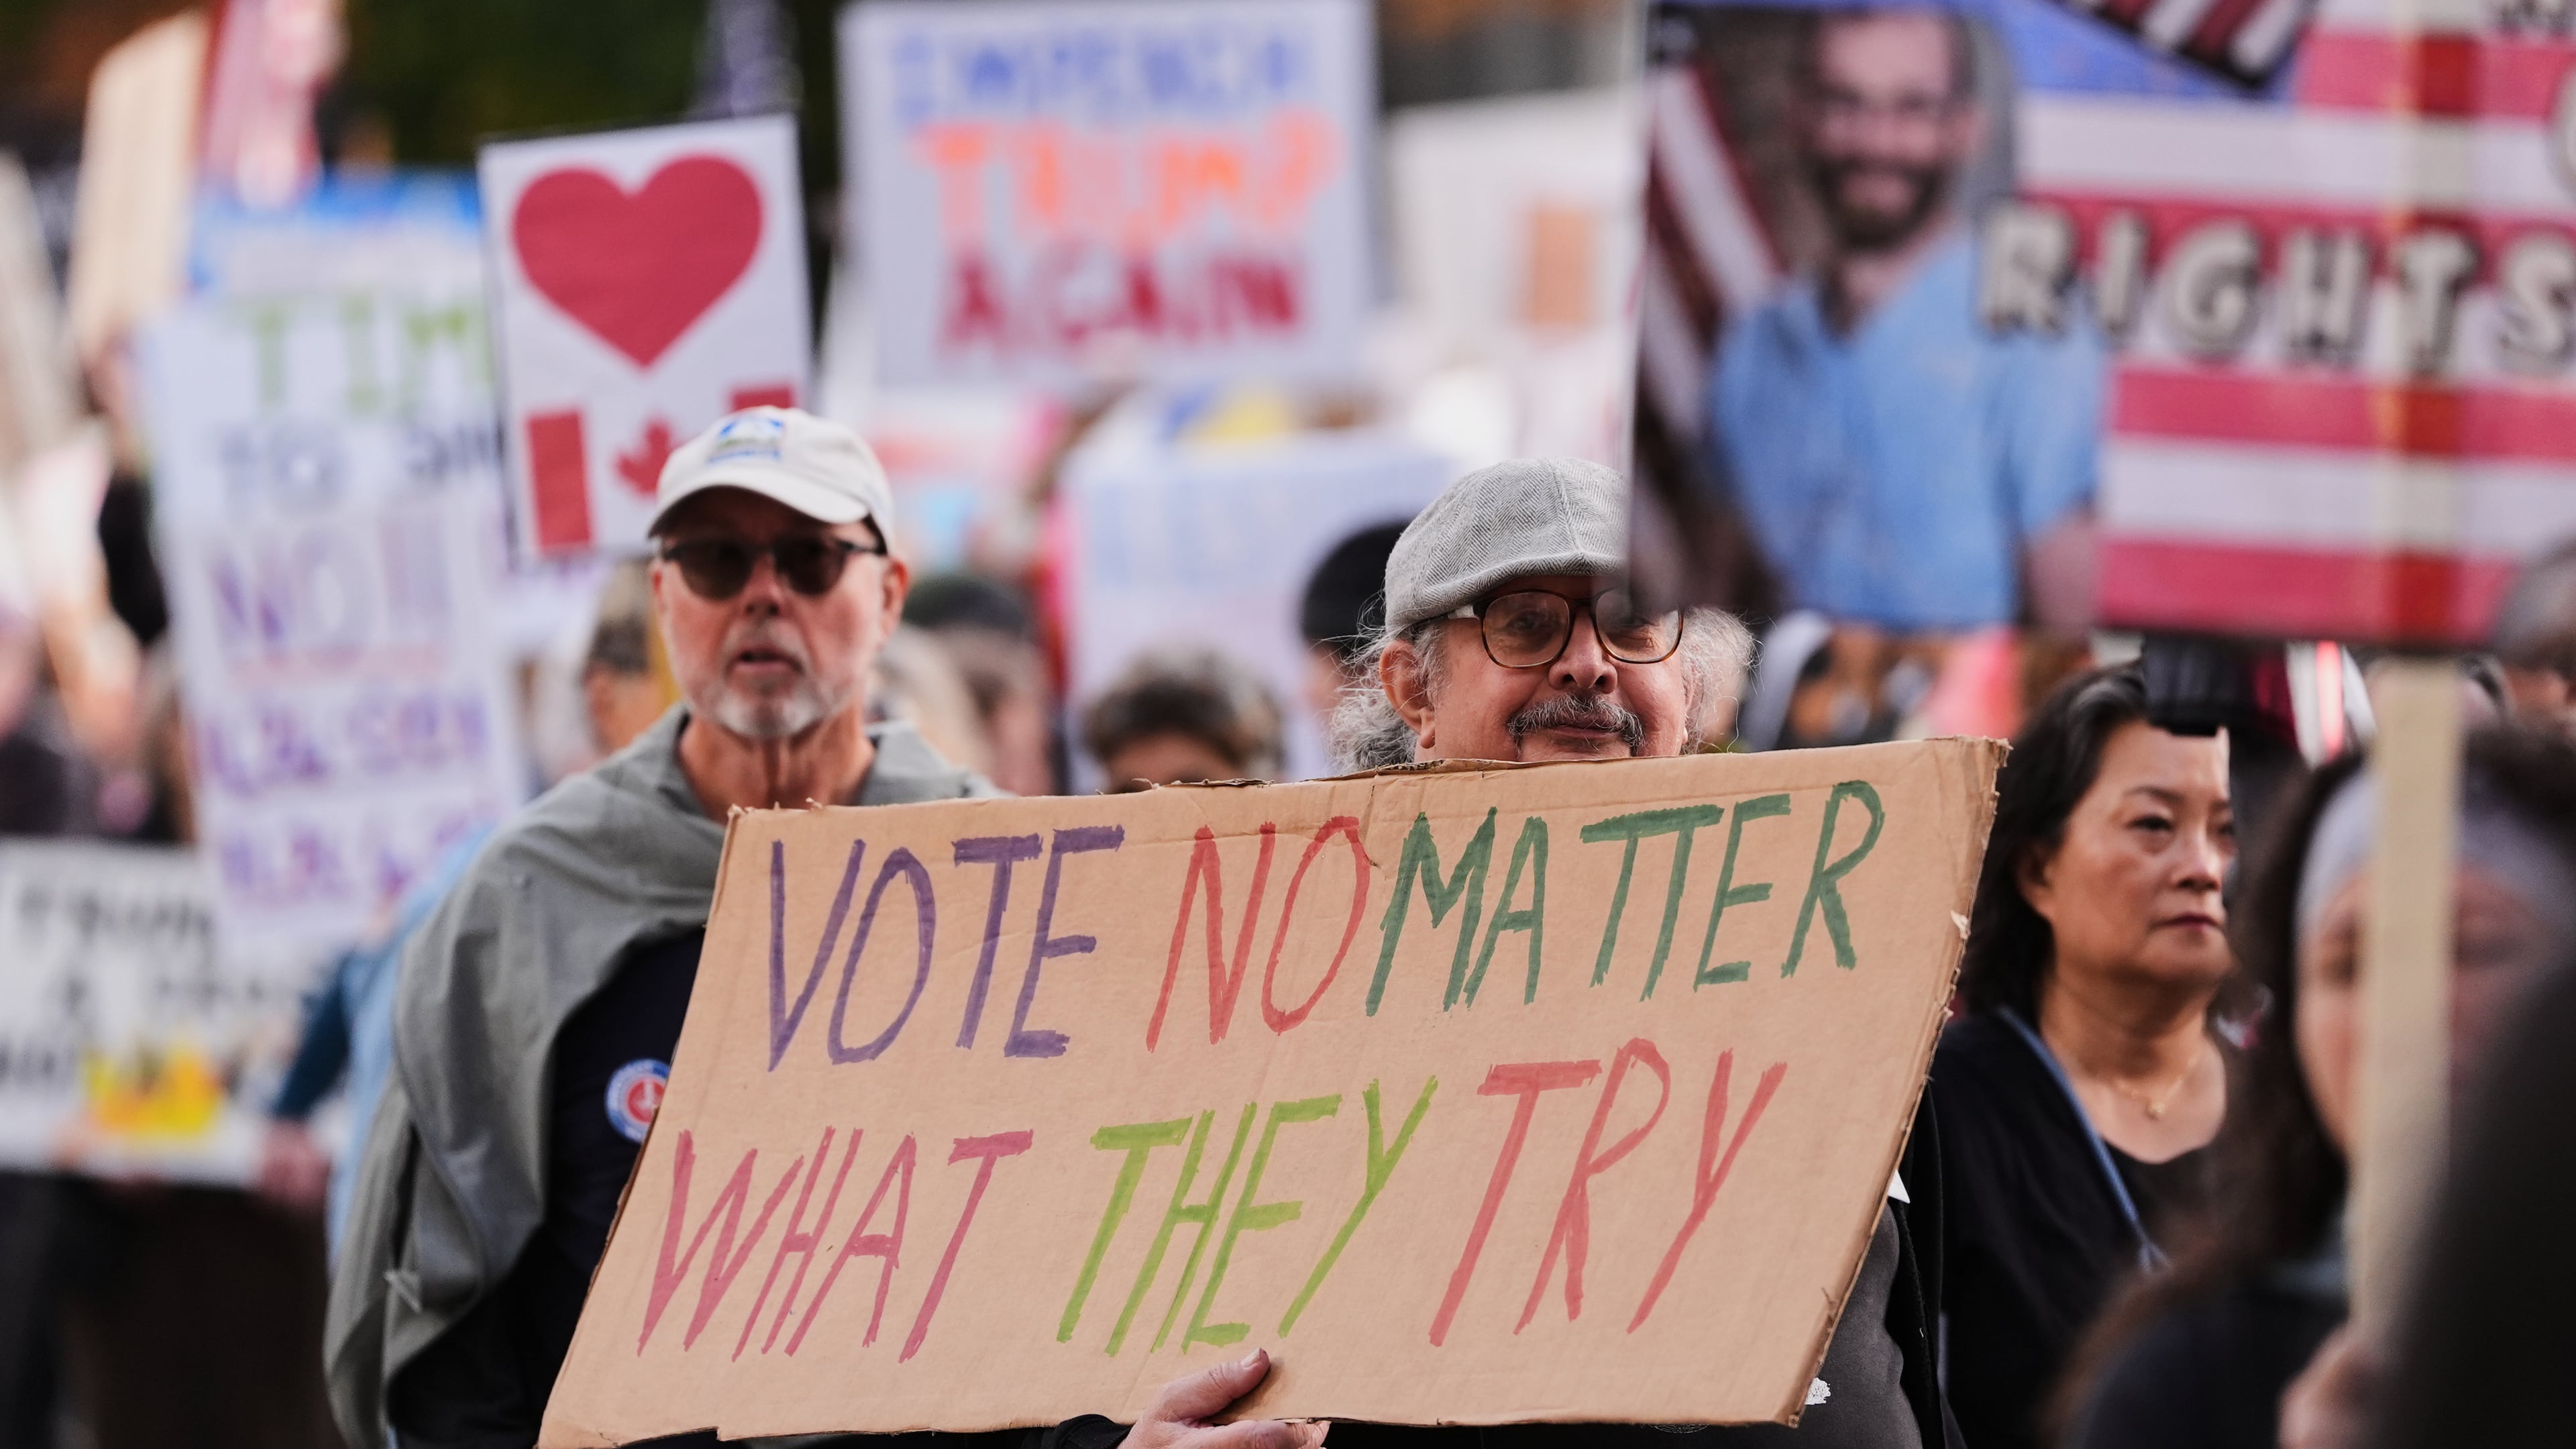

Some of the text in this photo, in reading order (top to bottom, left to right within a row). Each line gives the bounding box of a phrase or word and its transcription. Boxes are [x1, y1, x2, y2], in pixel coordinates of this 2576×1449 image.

[1974, 195, 2576, 381] RIGHTS
[768, 779, 1886, 1073] VOTE NO MATTER
[637, 1036, 1788, 1364] WHAT THEY TRY
